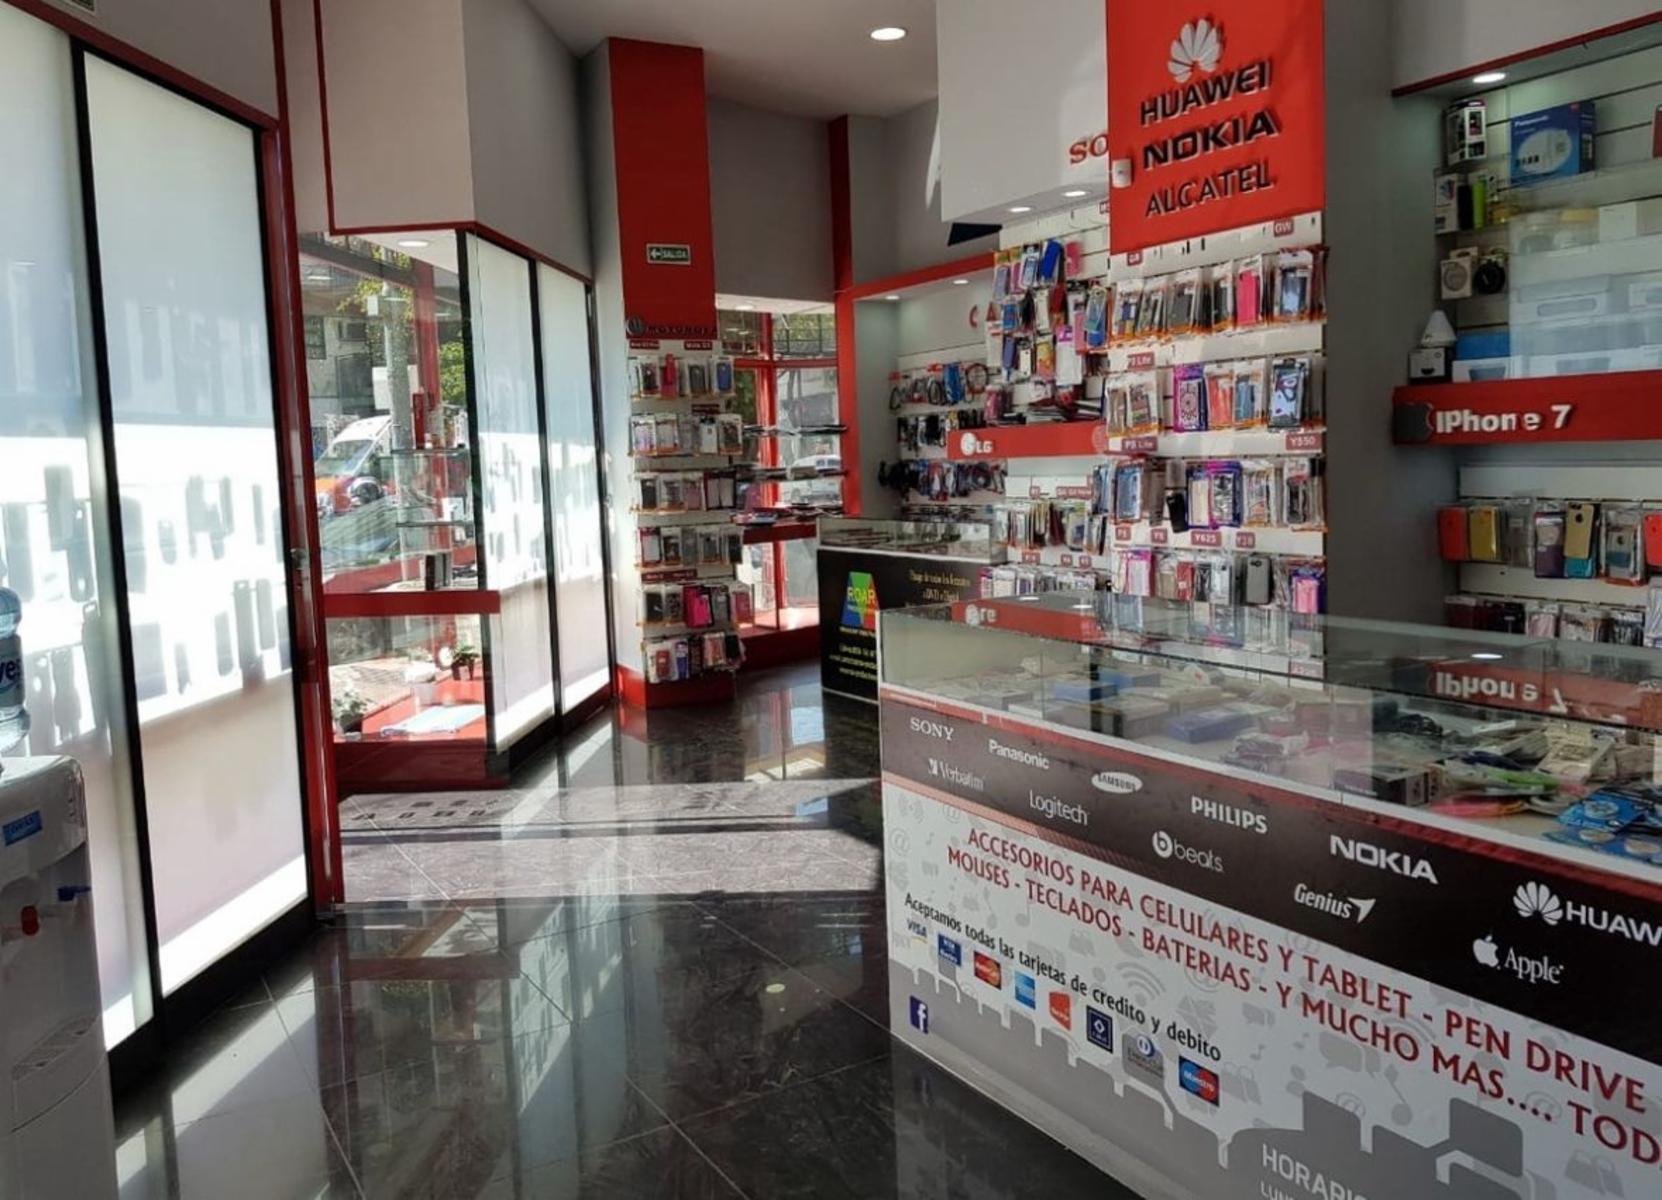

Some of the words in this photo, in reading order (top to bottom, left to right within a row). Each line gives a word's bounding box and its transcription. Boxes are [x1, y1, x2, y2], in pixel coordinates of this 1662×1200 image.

[1140, 60, 1272, 128] HUAWEI
[1143, 110, 1281, 171] NOKIA
[1146, 159, 1277, 218] ALCATEL
[1552, 405, 1572, 429] 7
[910, 717, 954, 741] SONY
[988, 739, 1050, 770] Panasonic
[1029, 790, 1088, 826] Logitech
[1191, 796, 1268, 834] PHILIPS
[1174, 837, 1224, 873] beats
[1330, 835, 1439, 884] NOKIA
[1294, 883, 1352, 919] Genius
[904, 892, 962, 932] Aceptamos
[965, 924, 996, 950] todas
[999, 937, 1014, 959] las
[1019, 951, 1066, 985] tarjetas
[1071, 975, 1087, 996] de
[1092, 989, 1146, 1025] credito
[1151, 1016, 1161, 1034] y
[1166, 1022, 1221, 1062] debito
[968, 828, 1075, 886] ACCESORIOS
[1081, 869, 1133, 910] PARA
[1140, 895, 1269, 964] CELULARES
[1278, 945, 1293, 972] Y
[1302, 955, 1412, 1019] TABLET
[1446, 1010, 1511, 1060] PEN
[1526, 1039, 1647, 1114] DRIVE
[1504, 947, 1561, 984] Apple
[947, 846, 1010, 889] MOUSES
[1025, 879, 1122, 938] TECLADOS
[1142, 927, 1251, 993] BATERIAS
[1276, 981, 1293, 1009] Y
[1302, 991, 1420, 1062] MUCHO
[1567, 1100, 1662, 1170] TOD
